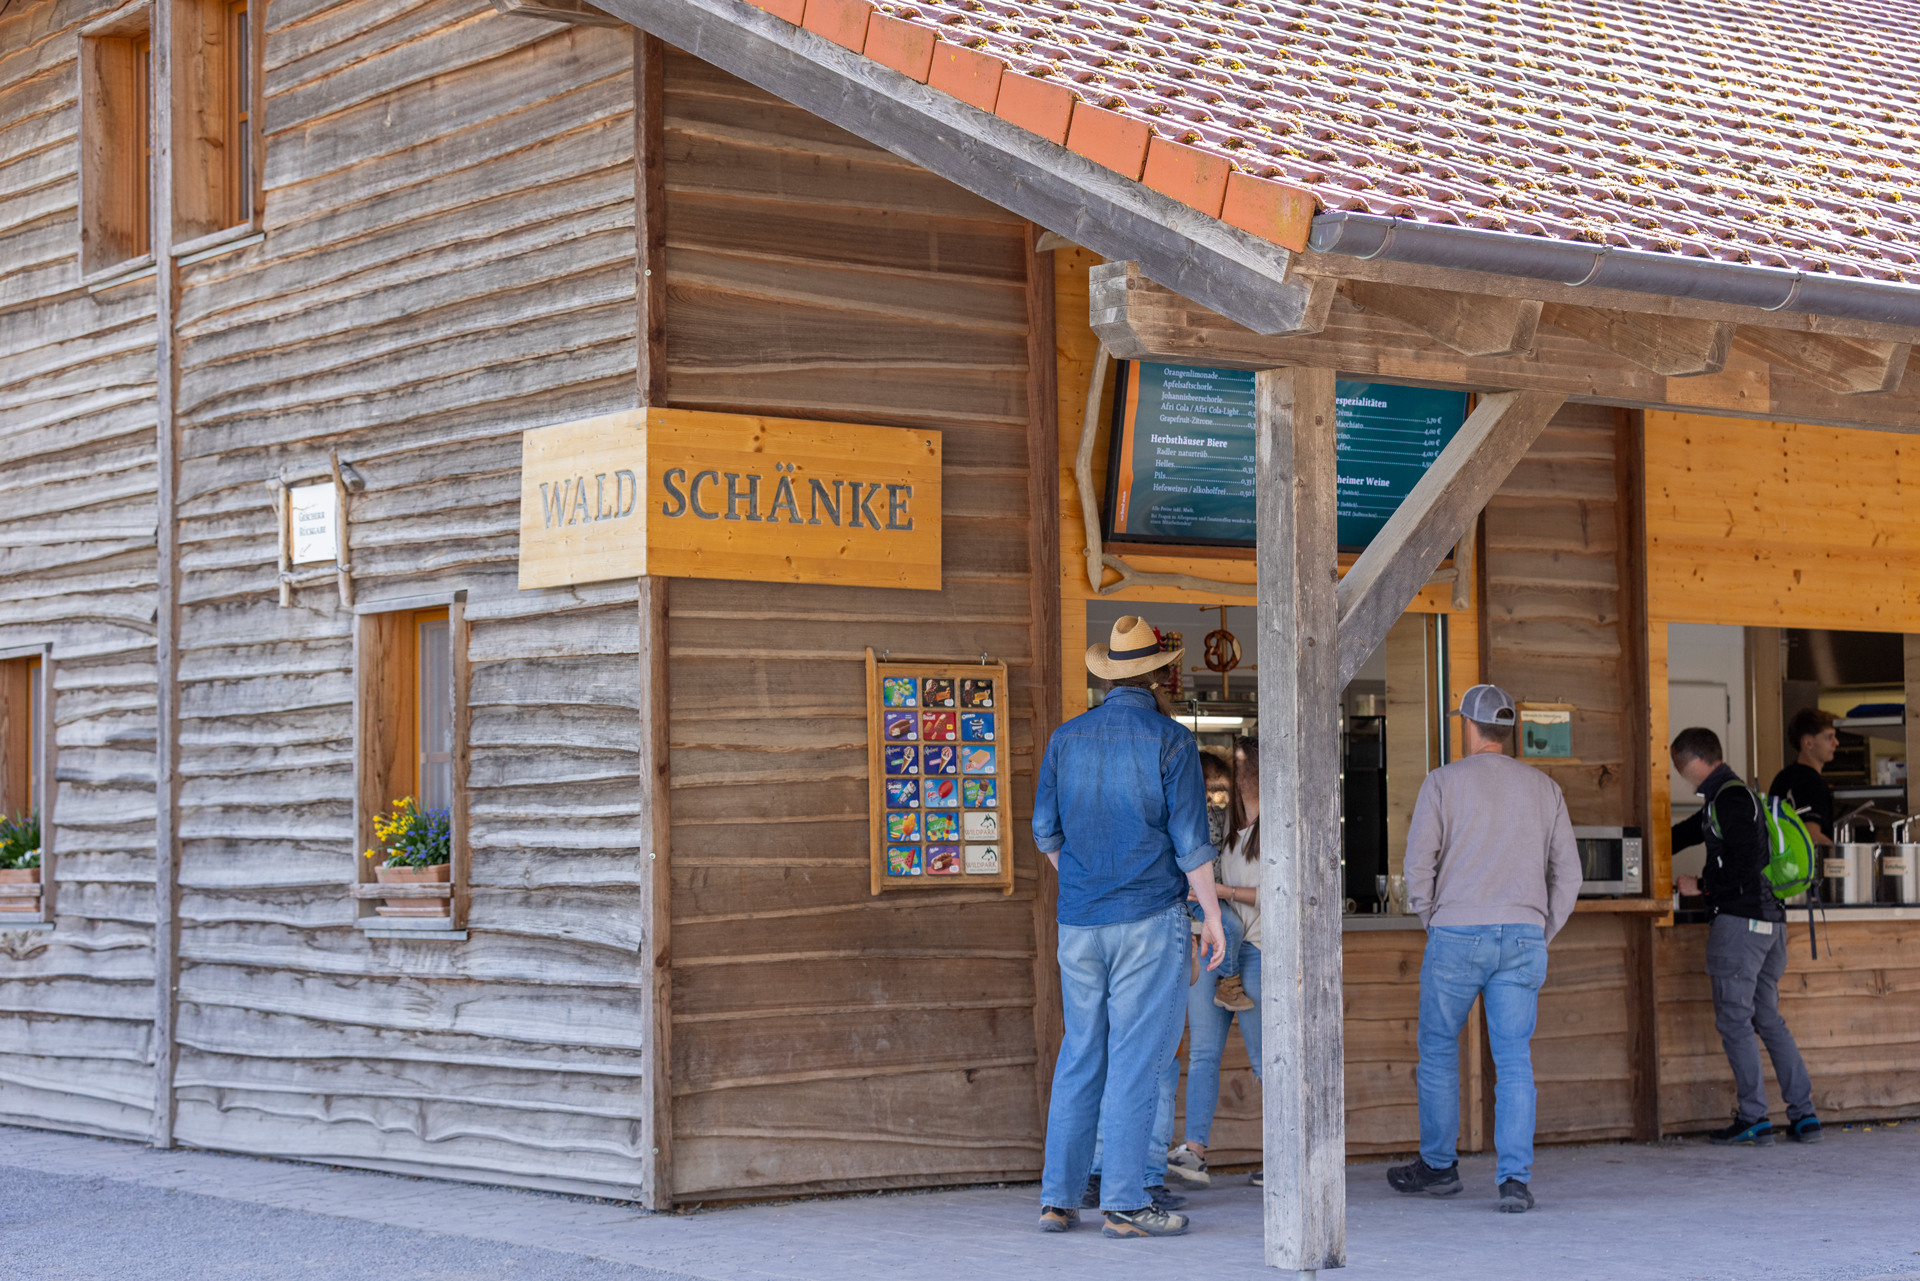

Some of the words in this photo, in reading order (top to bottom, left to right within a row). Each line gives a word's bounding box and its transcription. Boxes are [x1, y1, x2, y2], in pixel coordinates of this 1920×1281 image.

[1164, 368, 1218, 379] Orangenlimonade
[1163, 380, 1212, 391] Apfelsaftschorle
[1161, 391, 1222, 403] Johannisbeerschorle
[1336, 397, 1387, 408] espezialitäten
[1194, 405, 1207, 413] Afri
[1209, 406, 1239, 417] Cola-Light
[1160, 414, 1213, 425] Grapefruit-Zitrone
[1151, 434, 1205, 446] Herbsthäuser
[1207, 438, 1228, 448] Biere
[1156, 448, 1176, 456] Radler
[1337, 475, 1364, 485] heimer
[1366, 477, 1390, 487] Weine
[1153, 483, 1188, 493] Hefeweizen
[1193, 486, 1226, 495] alkoholfrei
[540, 469, 638, 530] WALD
[662, 461, 914, 531] SCHÄNKE
